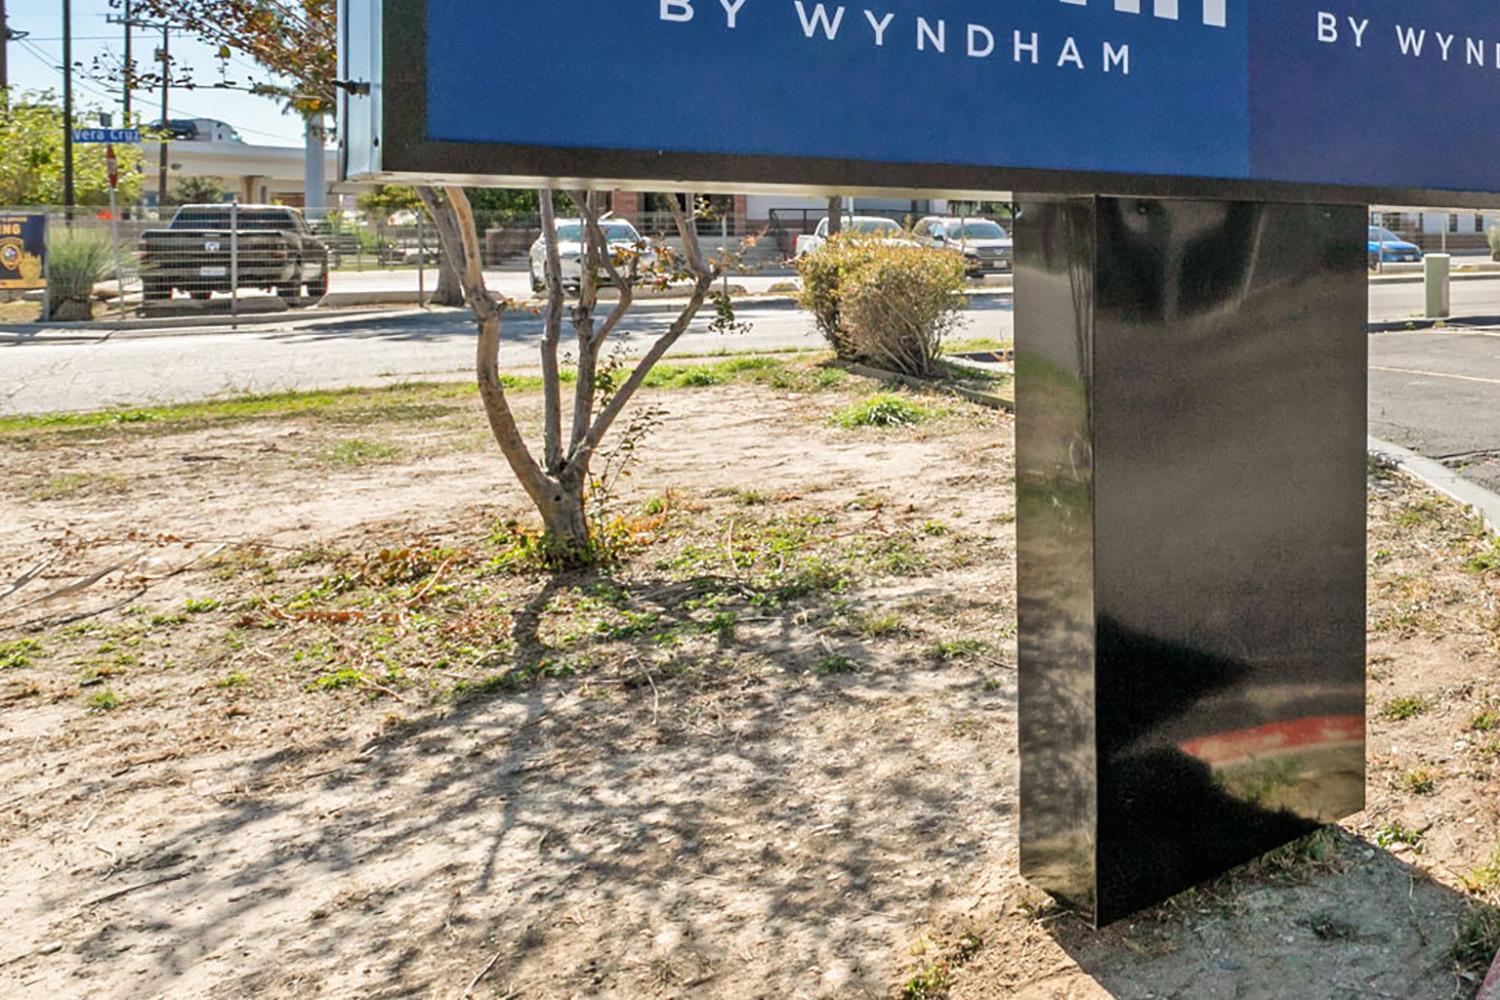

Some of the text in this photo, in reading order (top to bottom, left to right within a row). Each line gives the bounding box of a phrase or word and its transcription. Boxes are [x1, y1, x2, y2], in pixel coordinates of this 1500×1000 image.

[794, 0, 1131, 75] WYNDHAM
[1316, 10, 1370, 48] BY
[72, 129, 139, 141] Vera Cruz
